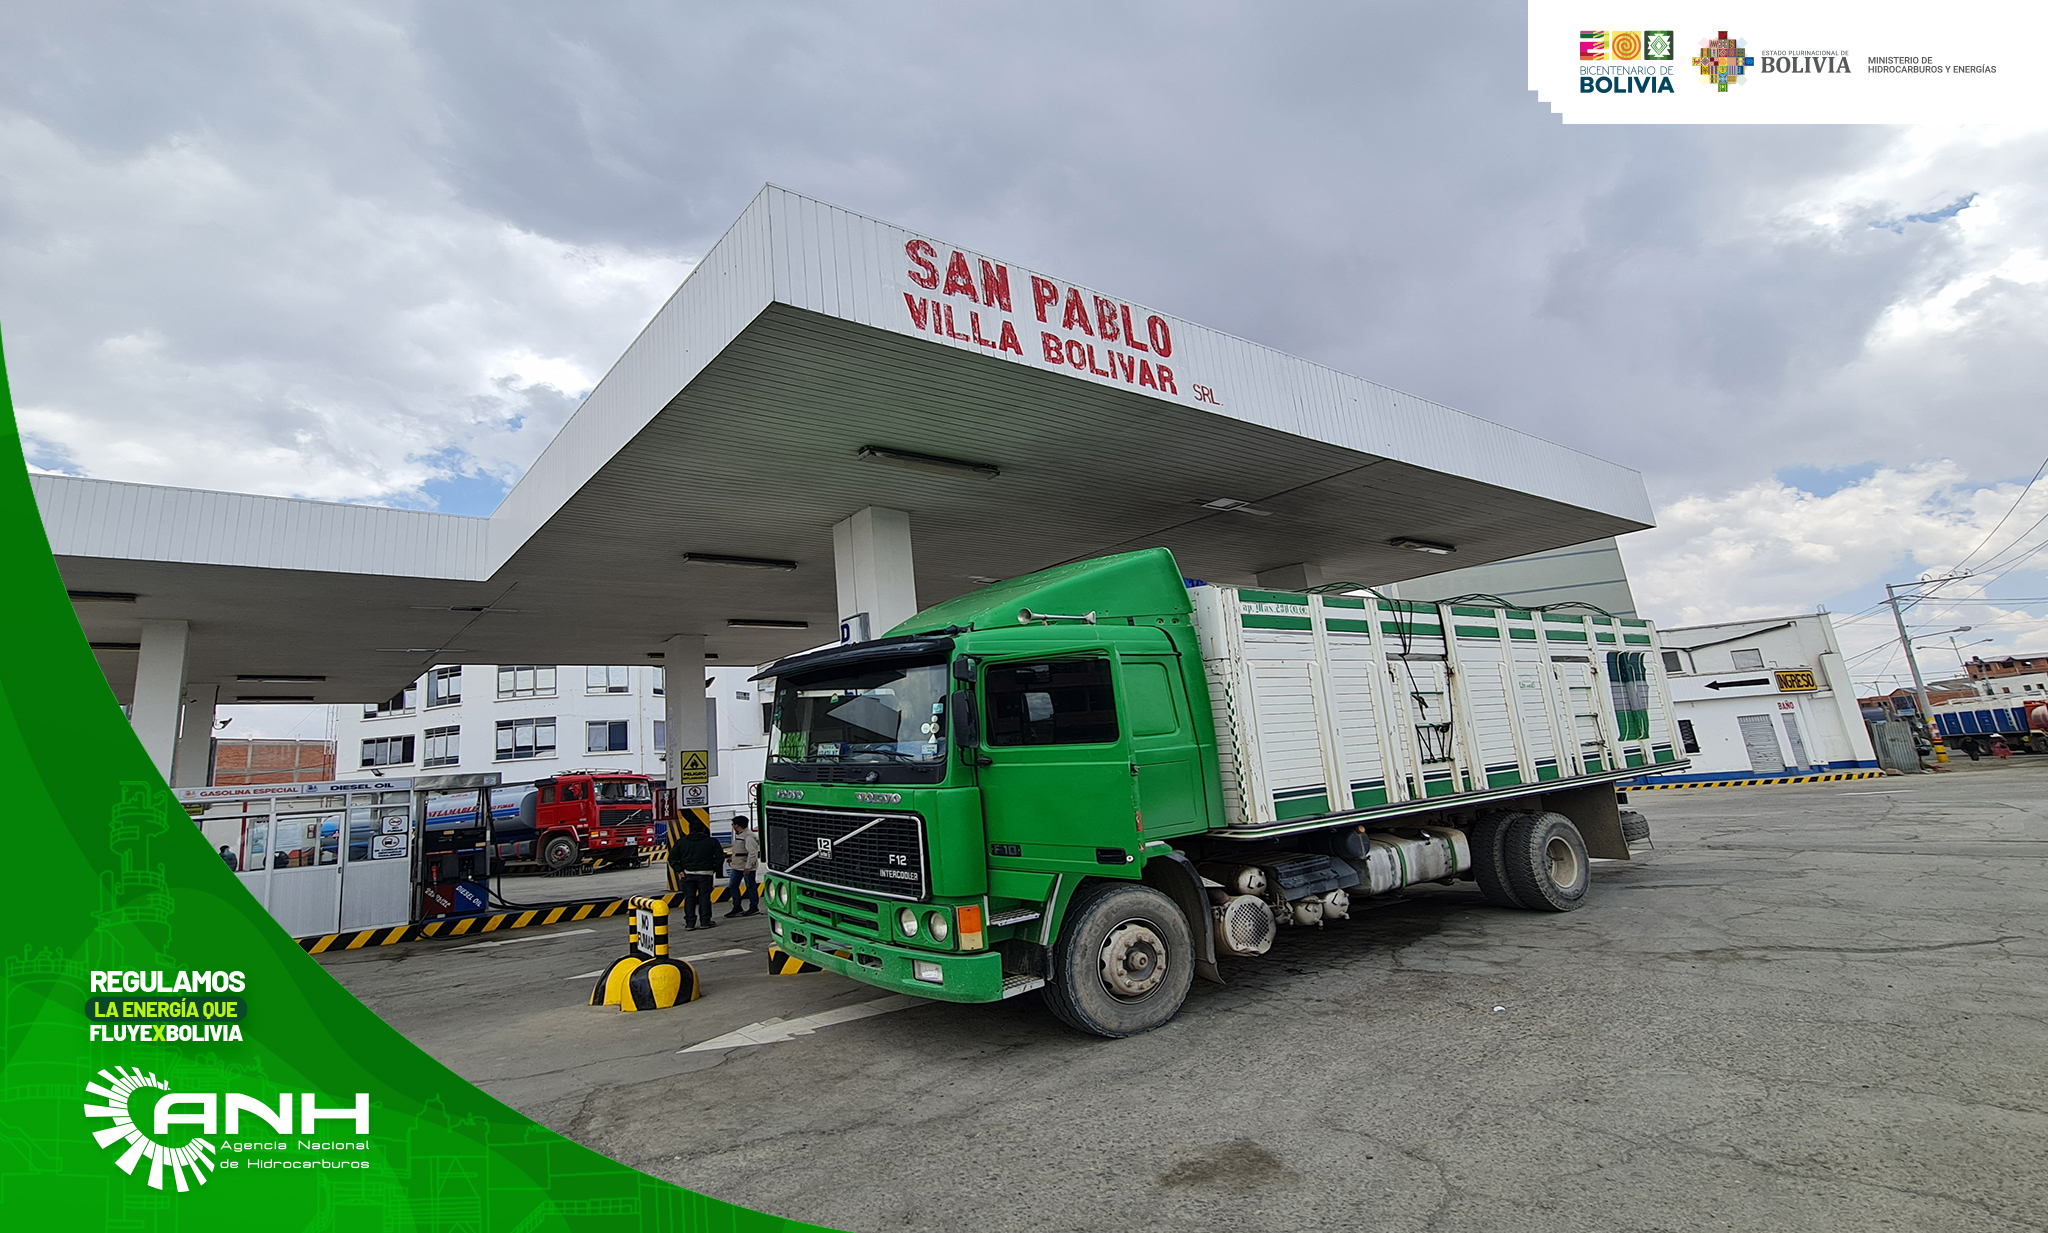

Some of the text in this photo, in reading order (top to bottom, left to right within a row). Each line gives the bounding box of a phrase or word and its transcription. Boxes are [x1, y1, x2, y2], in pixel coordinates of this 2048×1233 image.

[905, 239, 1173, 358] SAN PABLO
[903, 292, 1023, 356] VILLA
[1041, 330, 1178, 396] BOLIVAR
[1776, 673, 1815, 689] INGRESO
[1777, 700, 1795, 710] BAÑO
[200, 787, 299, 798] GASOLINA ESPECIAL
[329, 783, 372, 791] DIESEL
[855, 792, 901, 804] VOLVO
[428, 805, 478, 818] NFLAMABLE
[819, 838, 830, 850] 12
[888, 854, 907, 866] F12
[879, 869, 919, 880] INTERCOOLER
[455, 885, 483, 907] DIESEL OIL
[641, 913, 650, 931] NO
